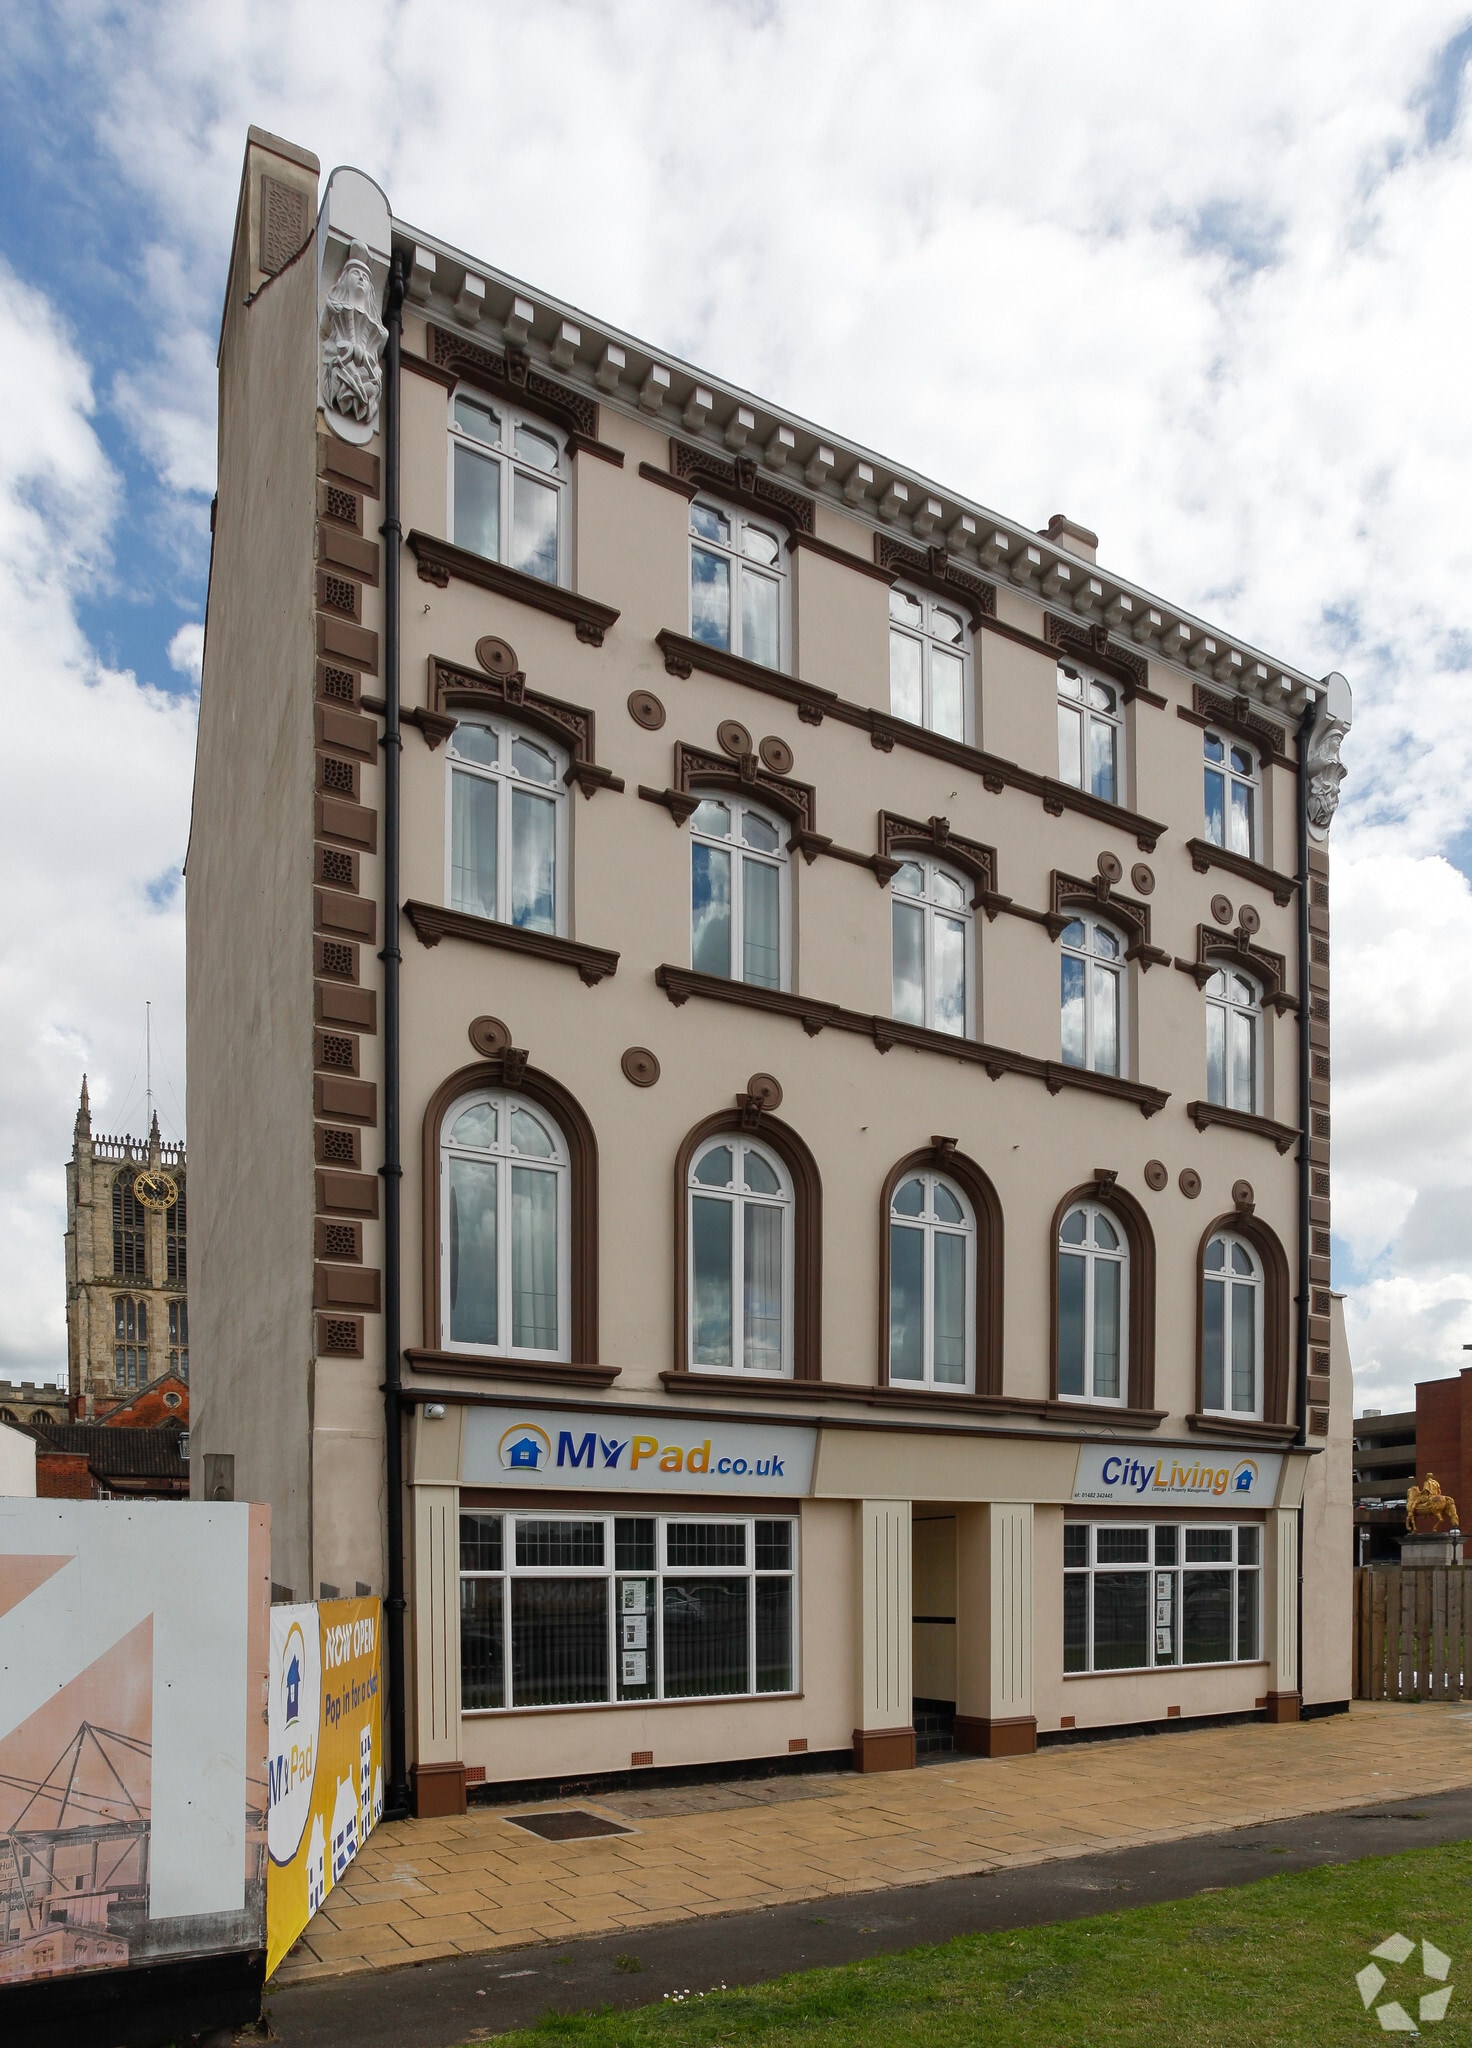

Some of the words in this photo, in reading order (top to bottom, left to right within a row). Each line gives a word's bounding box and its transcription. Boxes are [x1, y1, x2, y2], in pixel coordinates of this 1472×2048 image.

[325, 1623, 353, 1671] NOW
[353, 1617, 375, 1659] OPEN
[325, 1693, 341, 1730] Pop
[342, 1684, 350, 1717] in
[351, 1677, 361, 1710] for
[361, 1686, 366, 1702] a
